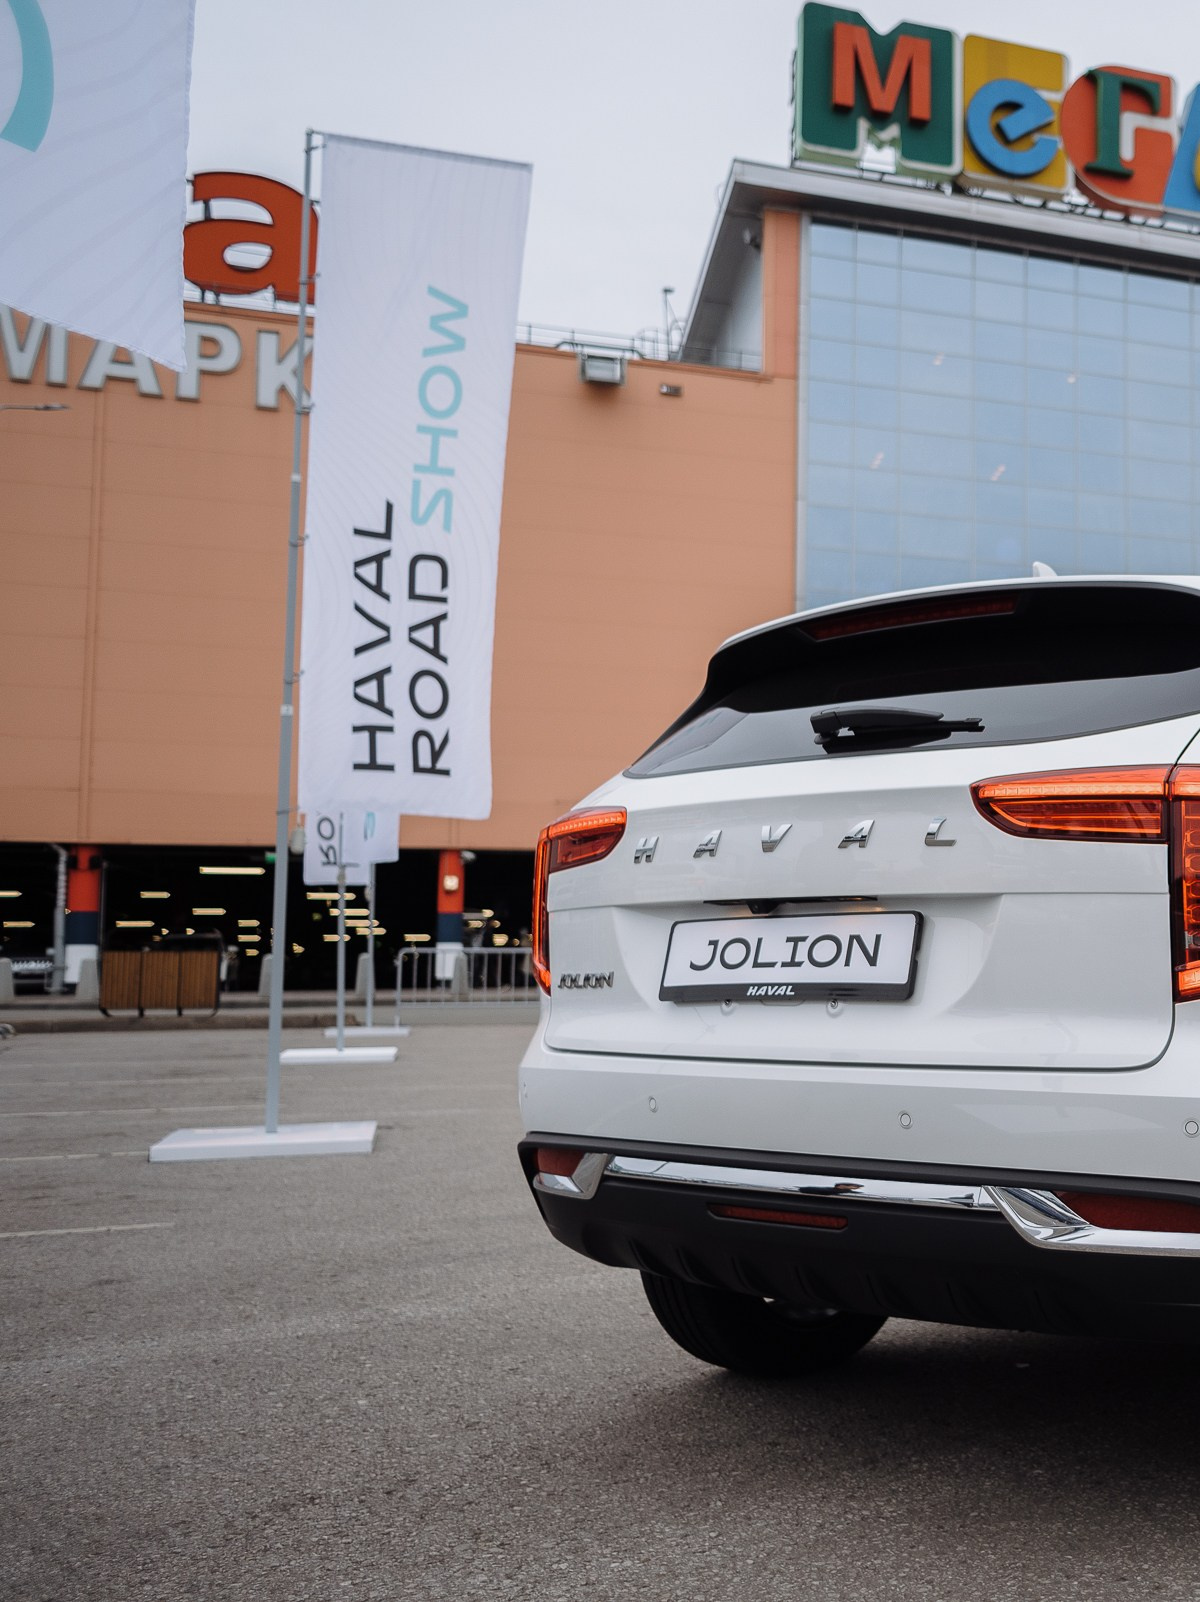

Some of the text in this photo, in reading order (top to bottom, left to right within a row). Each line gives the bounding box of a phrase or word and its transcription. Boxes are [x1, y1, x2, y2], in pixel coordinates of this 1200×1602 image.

[408, 284, 469, 777] ROAD SHOW
[352, 498, 395, 773] HAVAL
[633, 816, 957, 864] HAVAL
[688, 932, 883, 971] JOLION
[557, 971, 615, 989] JOLION
[746, 985, 796, 997] HAVAL
